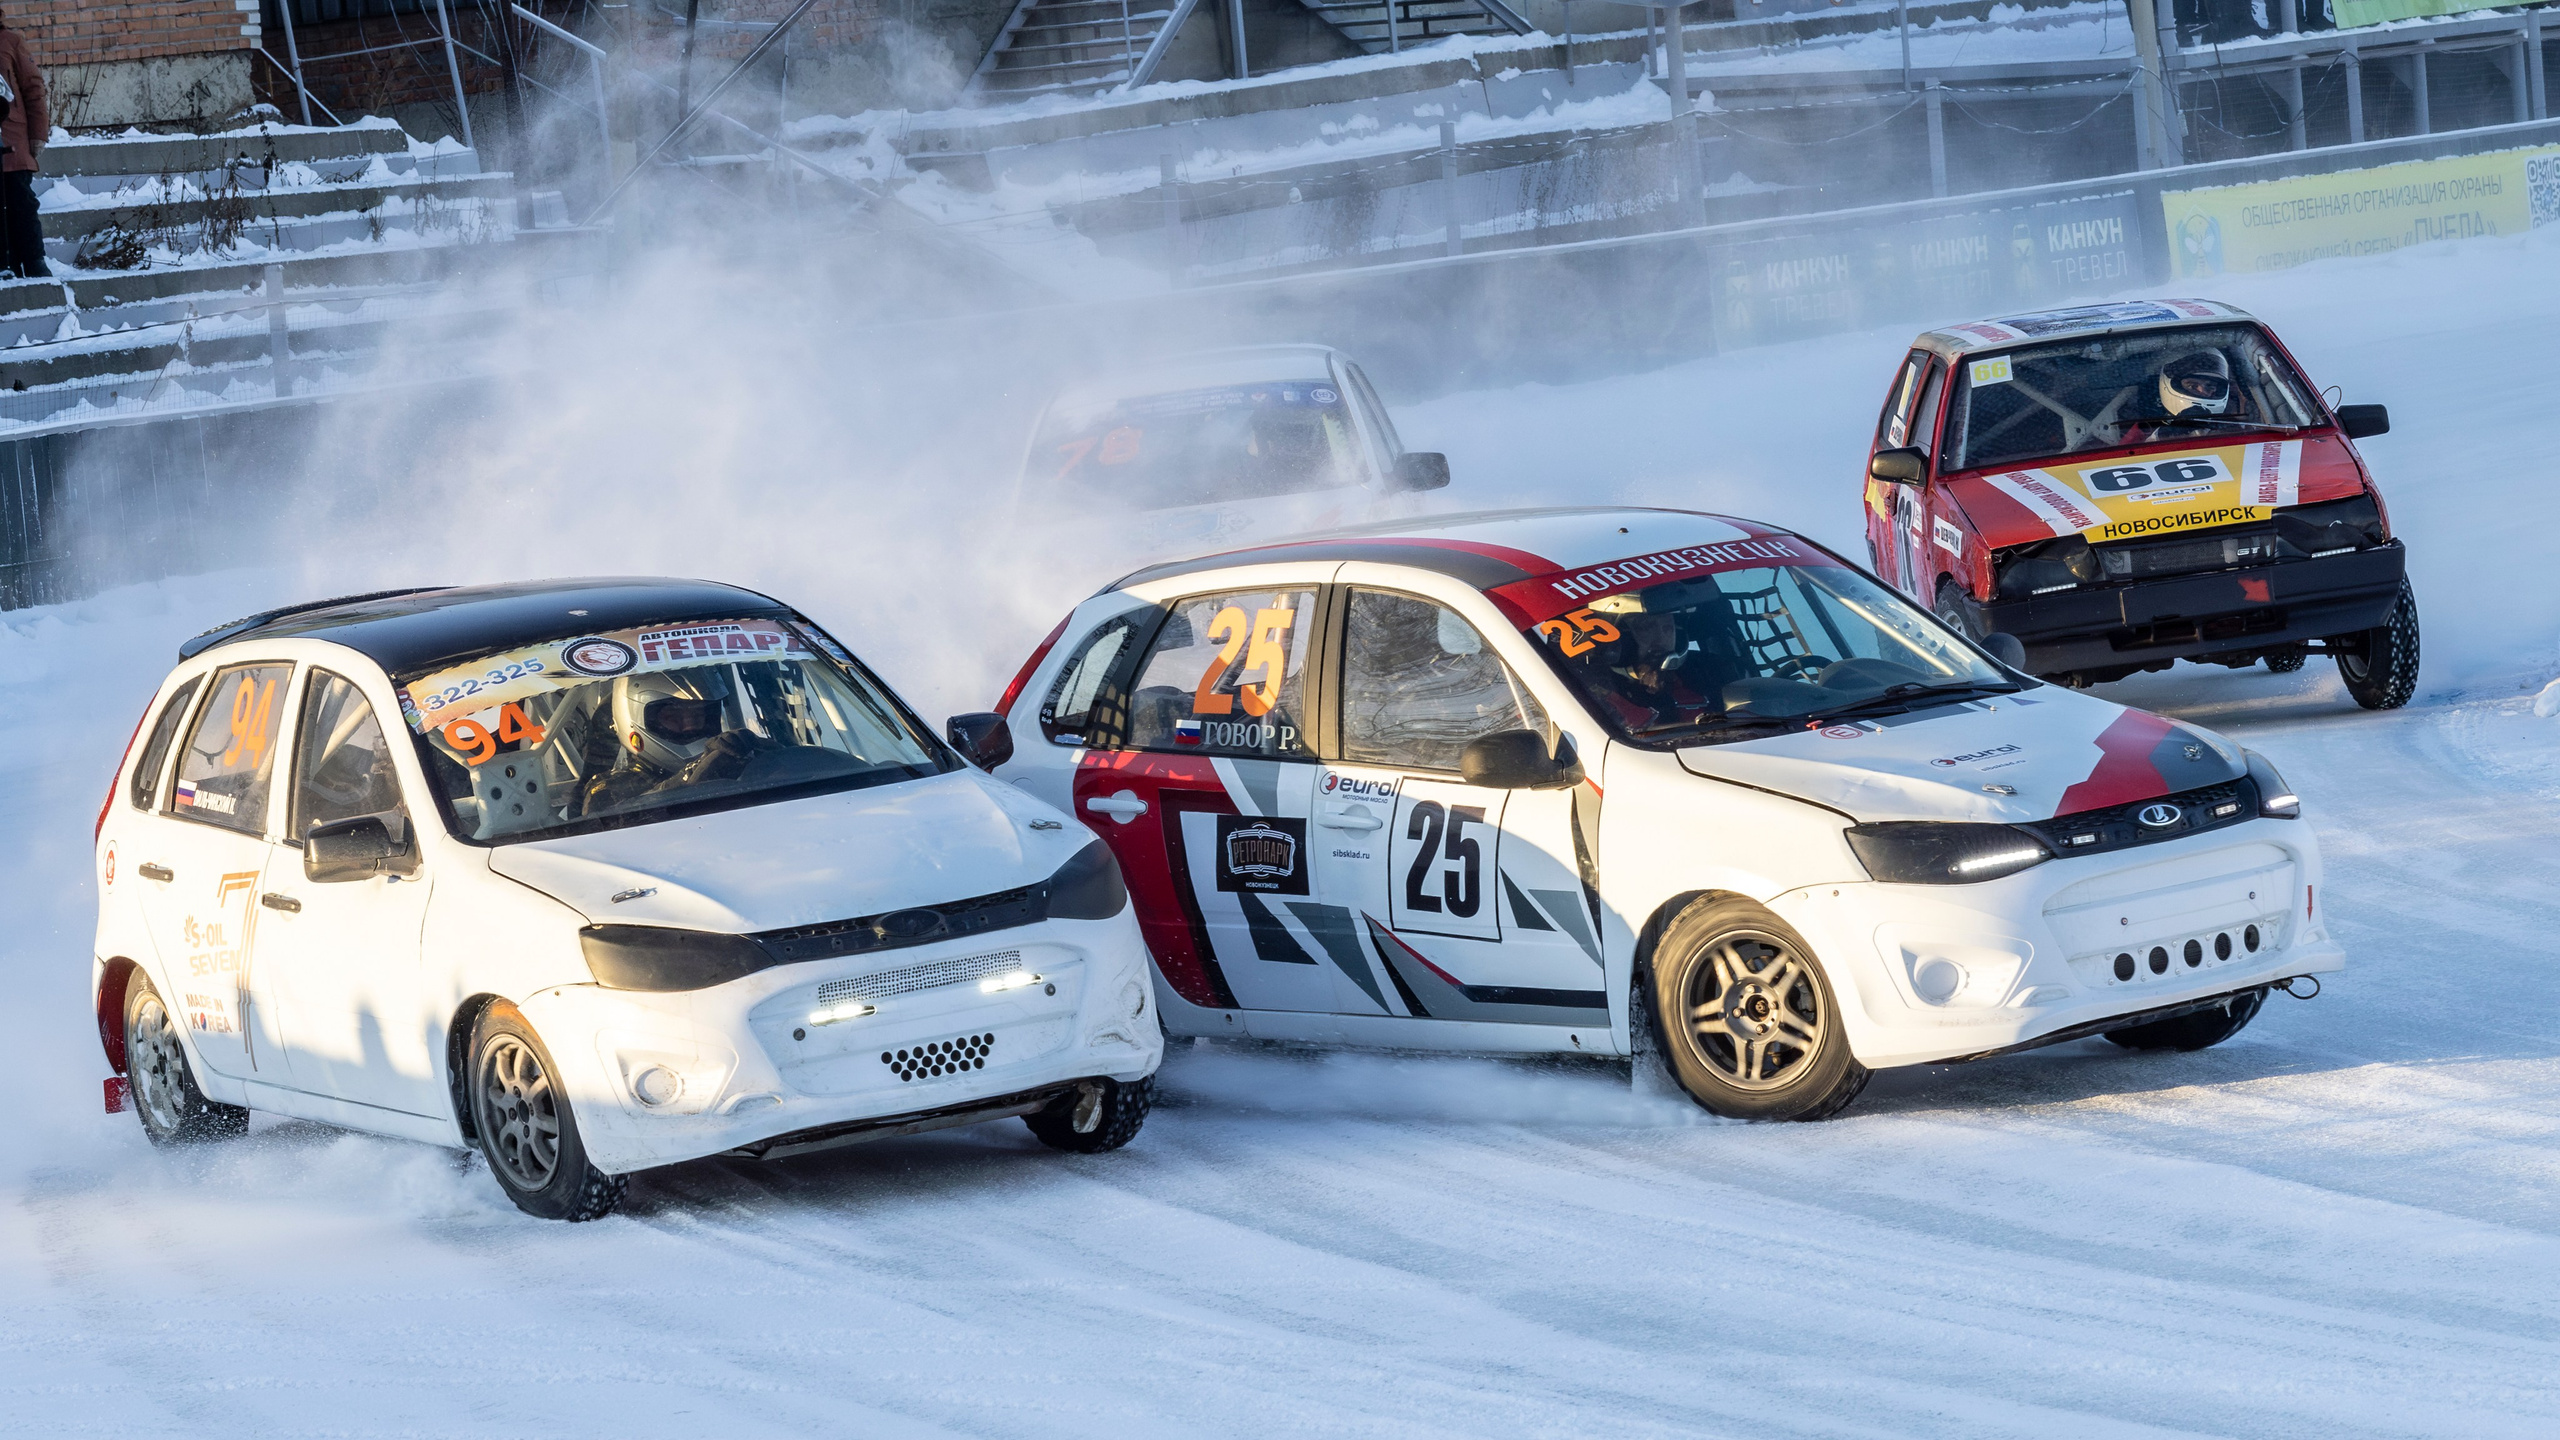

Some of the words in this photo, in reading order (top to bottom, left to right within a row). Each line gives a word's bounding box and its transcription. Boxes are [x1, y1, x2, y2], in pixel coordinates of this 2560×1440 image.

[2242, 193, 2350, 228] ОБЩЕСТВЕННАЯ
[2354, 180, 2446, 214] ОРГАНИЗАЦИЯ
[2450, 174, 2502, 200] ОХРАНЫ
[2047, 217, 2123, 253] КАНКУН
[1910, 235, 1988, 269] КАНКУН
[1766, 254, 1849, 290] КАНКУН
[2051, 251, 2128, 286] ТРЕВЕЛ
[1974, 361, 2008, 382] 66
[2089, 458, 2217, 491] 66
[2152, 484, 2210, 498] eurol
[2103, 506, 2256, 538] НОВОСИБИРСК
[1552, 540, 1800, 600] НОВОКУЗНЕЦК
[641, 625, 741, 641] АВТОШКОЛА
[1540, 608, 1621, 658] 25
[1193, 606, 1294, 717] 25
[424, 657, 546, 711] 322-325
[223, 676, 276, 769] 94
[443, 702, 546, 767] 94
[1204, 721, 1275, 748] ГОВОР
[1278, 726, 1302, 751] Р.
[1954, 744, 2022, 763] eurol
[1338, 776, 1400, 797] eurol
[1232, 838, 1290, 867] РЕТРОПАРК
[1332, 849, 1370, 860] sibsklad.ru
[1406, 800, 1486, 918] 25
[1245, 881, 1279, 889] НОВОКУЗНЕЦК
[189, 950, 240, 977] SEVEN
[186, 994, 212, 1009] MADE
[213, 998, 224, 1013] IN
[190, 1012, 233, 1033] KOREA
